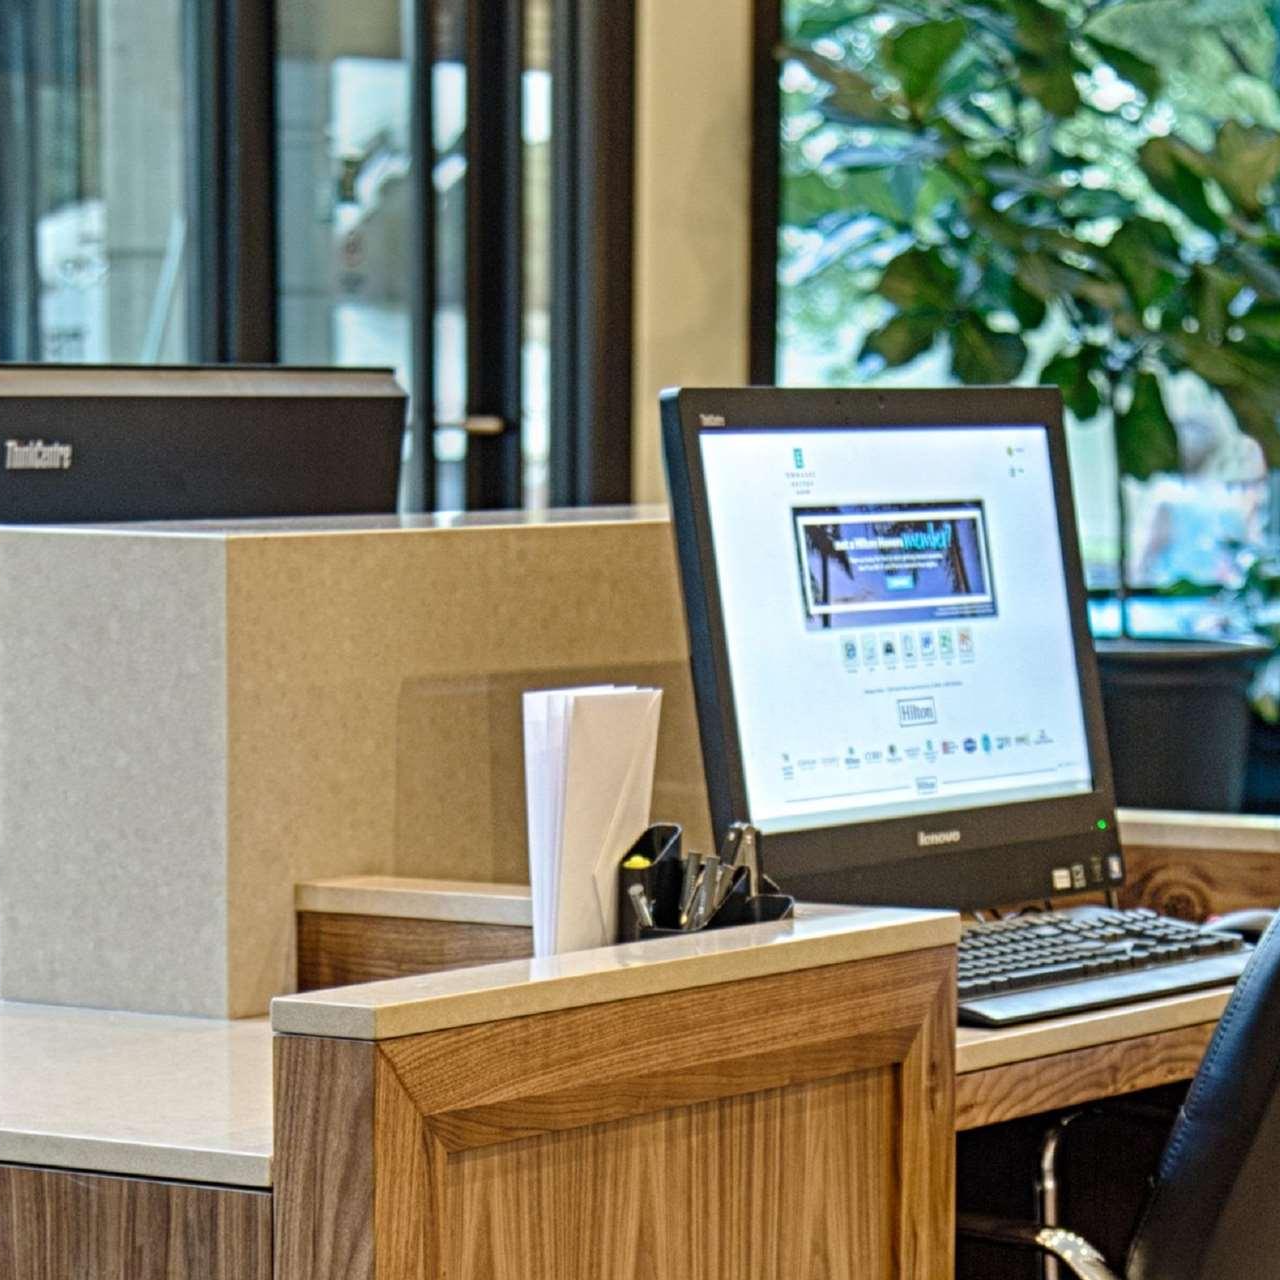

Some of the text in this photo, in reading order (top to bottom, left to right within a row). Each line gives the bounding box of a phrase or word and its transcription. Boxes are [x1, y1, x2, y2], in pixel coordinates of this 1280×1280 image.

[5, 439, 72, 470] ThinkCentre
[901, 703, 934, 721] Hilton
[918, 830, 961, 847] lenovo
